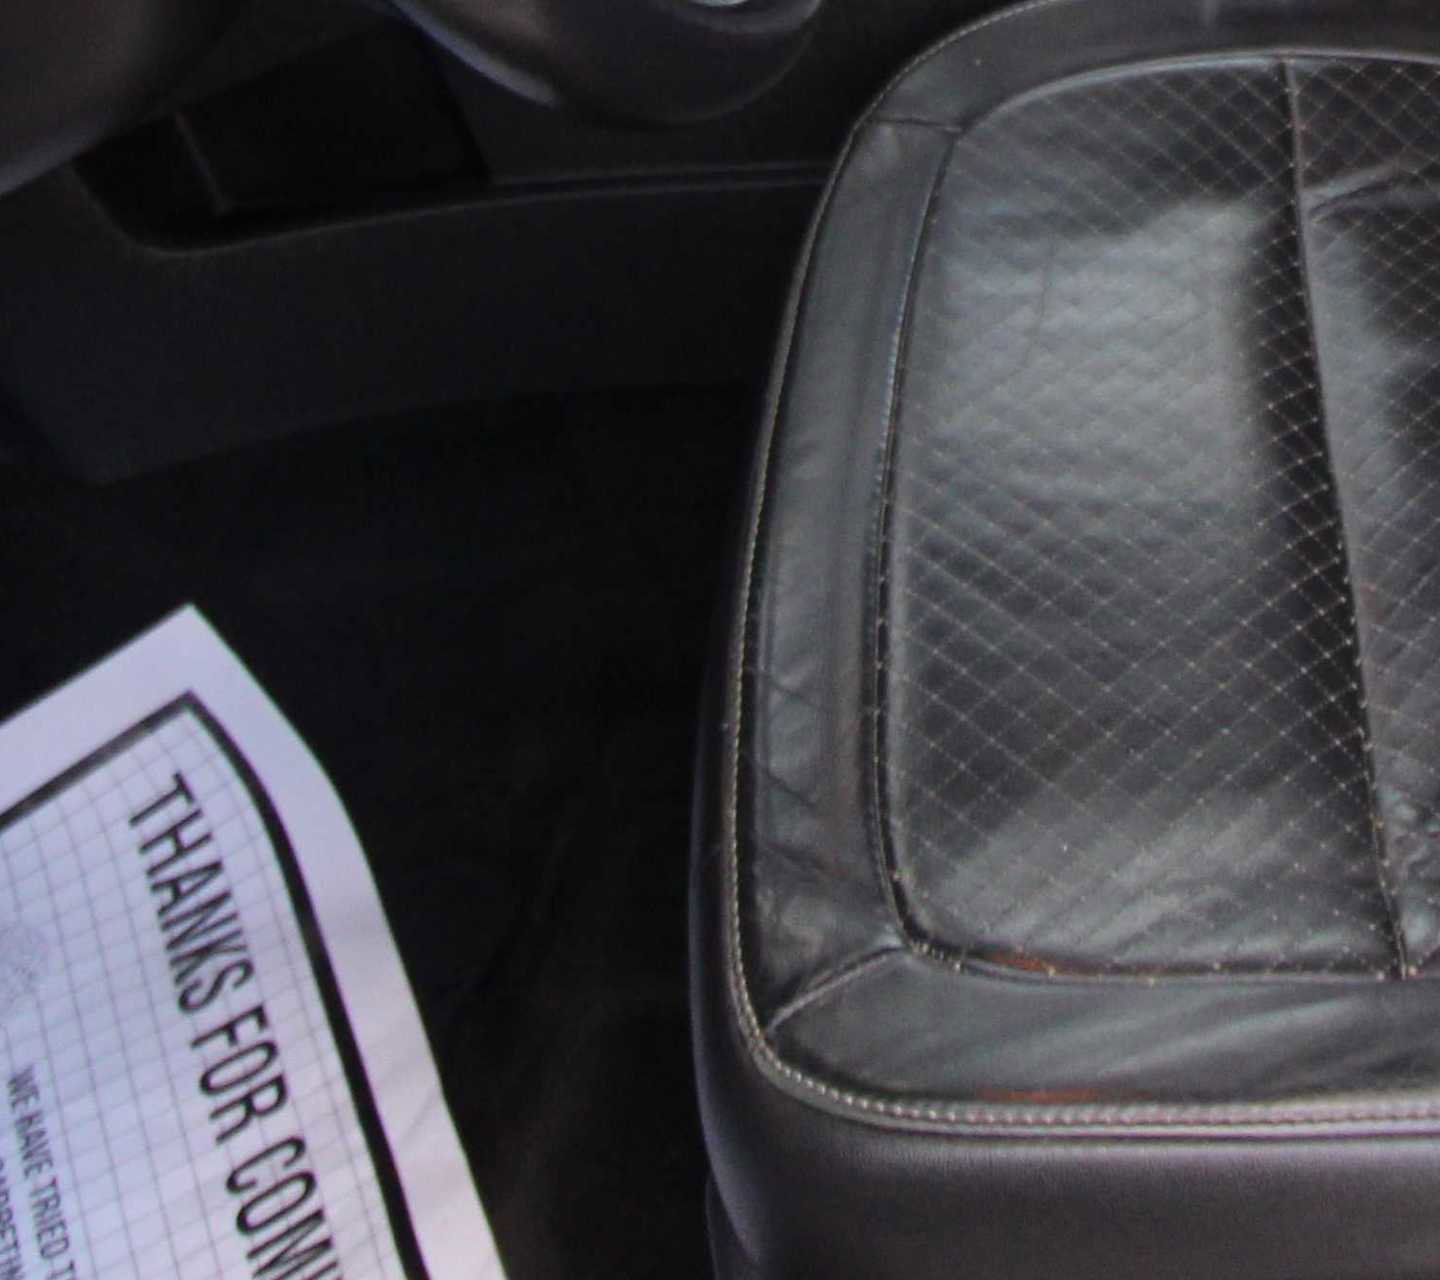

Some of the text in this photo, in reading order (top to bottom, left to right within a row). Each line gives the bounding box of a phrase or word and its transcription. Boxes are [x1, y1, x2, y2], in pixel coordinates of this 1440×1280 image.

[129, 771, 256, 1015] THANKS
[8, 1064, 40, 1113] WE
[191, 1003, 290, 1146] FOR
[14, 1110, 54, 1181] HAVE
[29, 1176, 70, 1261] TRIED
